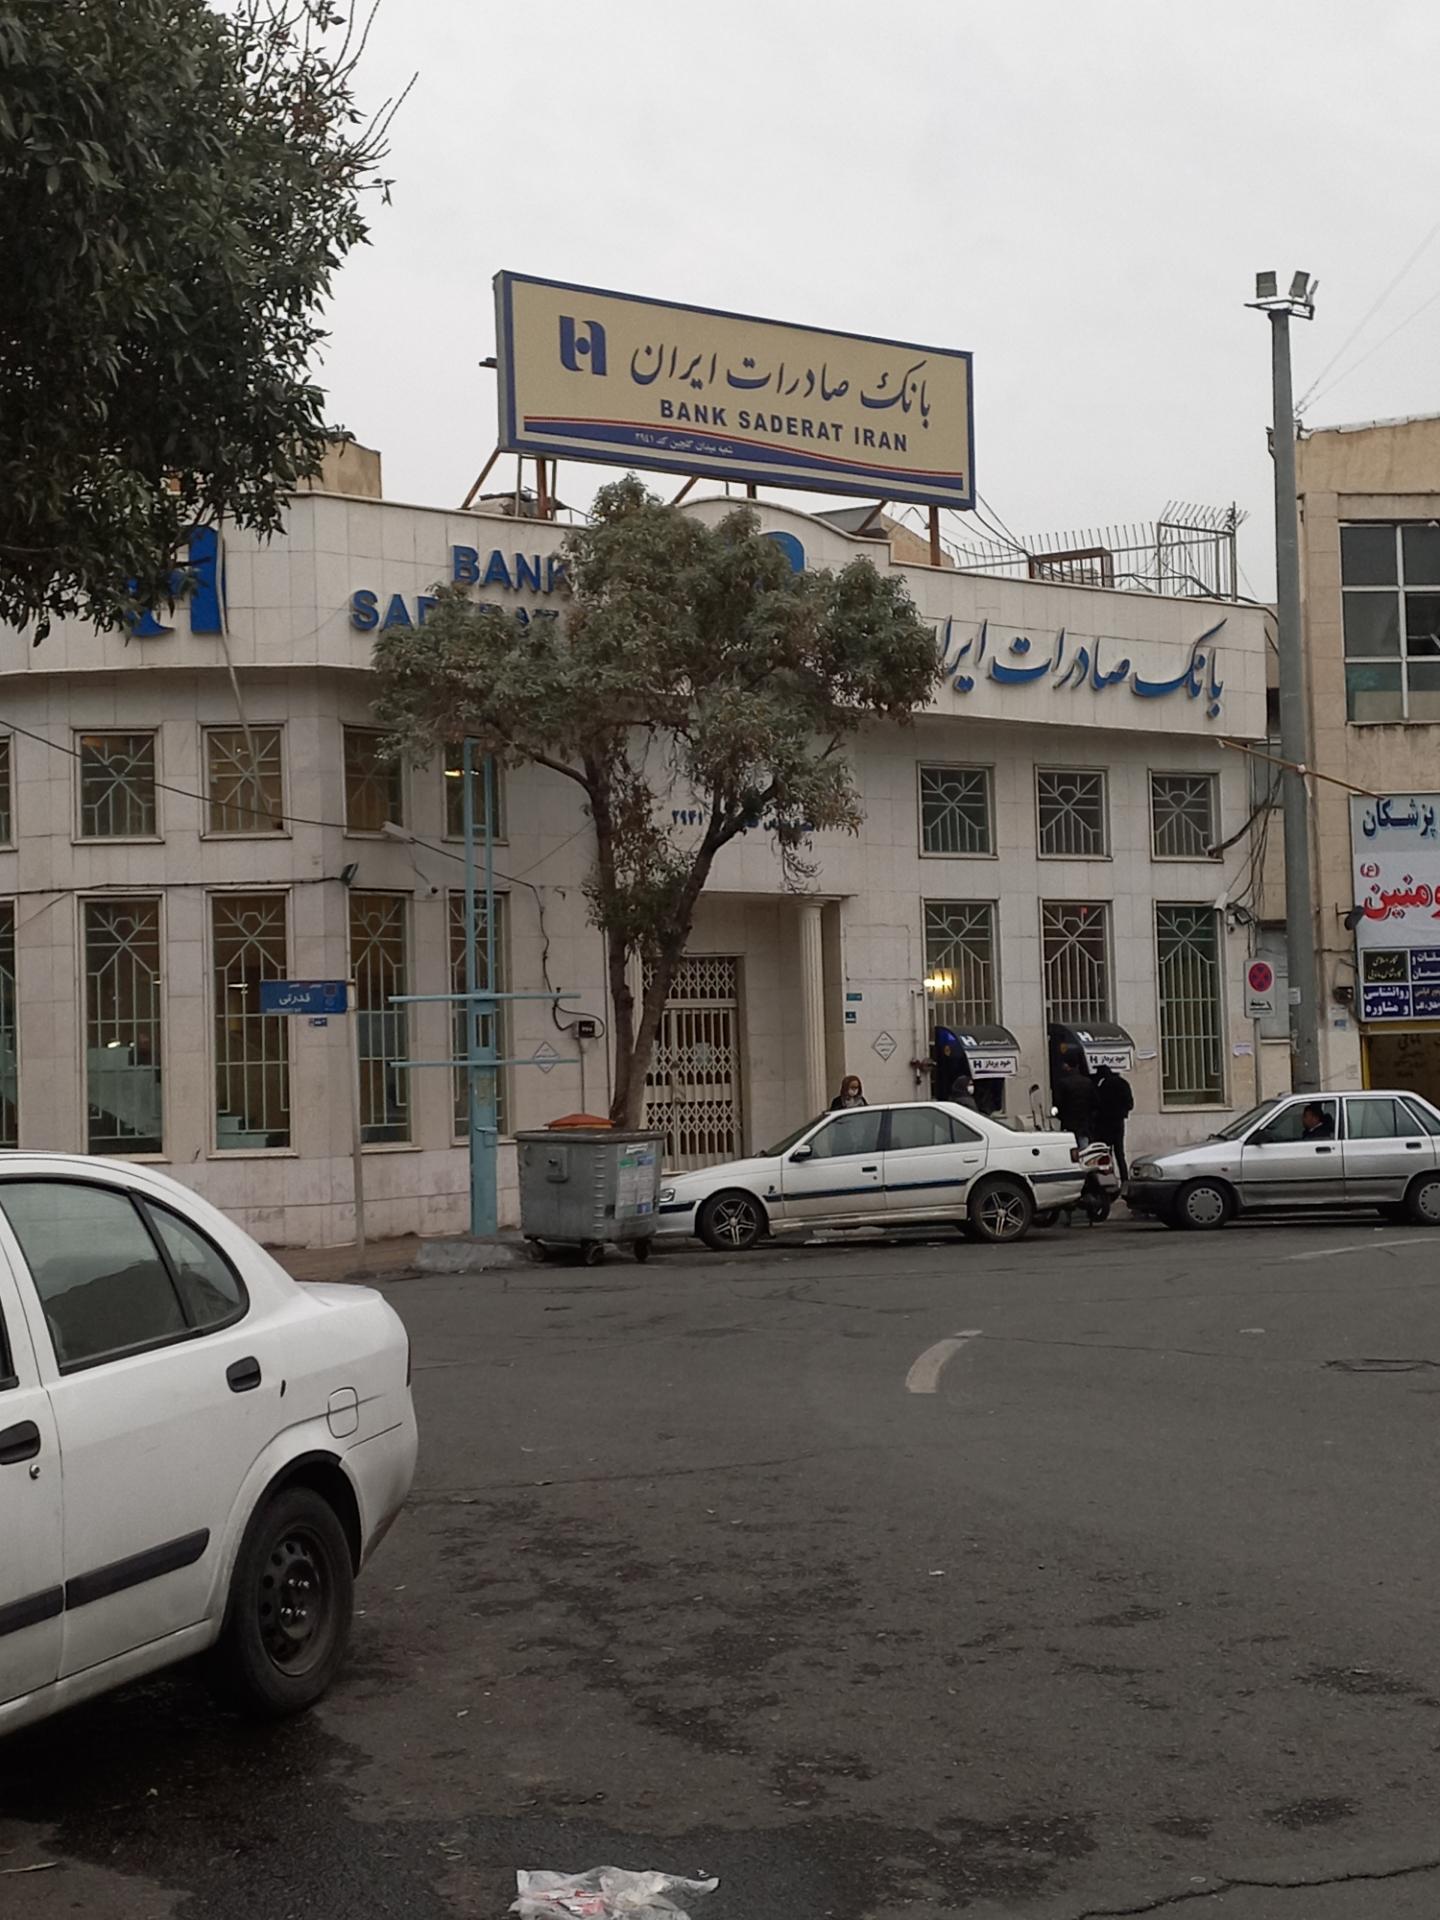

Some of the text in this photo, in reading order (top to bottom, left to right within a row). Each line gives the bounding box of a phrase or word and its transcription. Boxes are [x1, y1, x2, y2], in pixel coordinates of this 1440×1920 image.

[630, 342, 718, 390] ایران
[726, 355, 851, 402] صادرات
[659, 398, 909, 453] BANK SADERAT IRAN
[934, 614, 1229, 719] بانک صادرات ایرا
[1362, 798, 1437, 838] پزشکان
[1364, 986, 1409, 1000] روانشناسی
[1365, 1001, 1399, 1016] مشاوره
[1403, 1004, 1409, 1015] و
